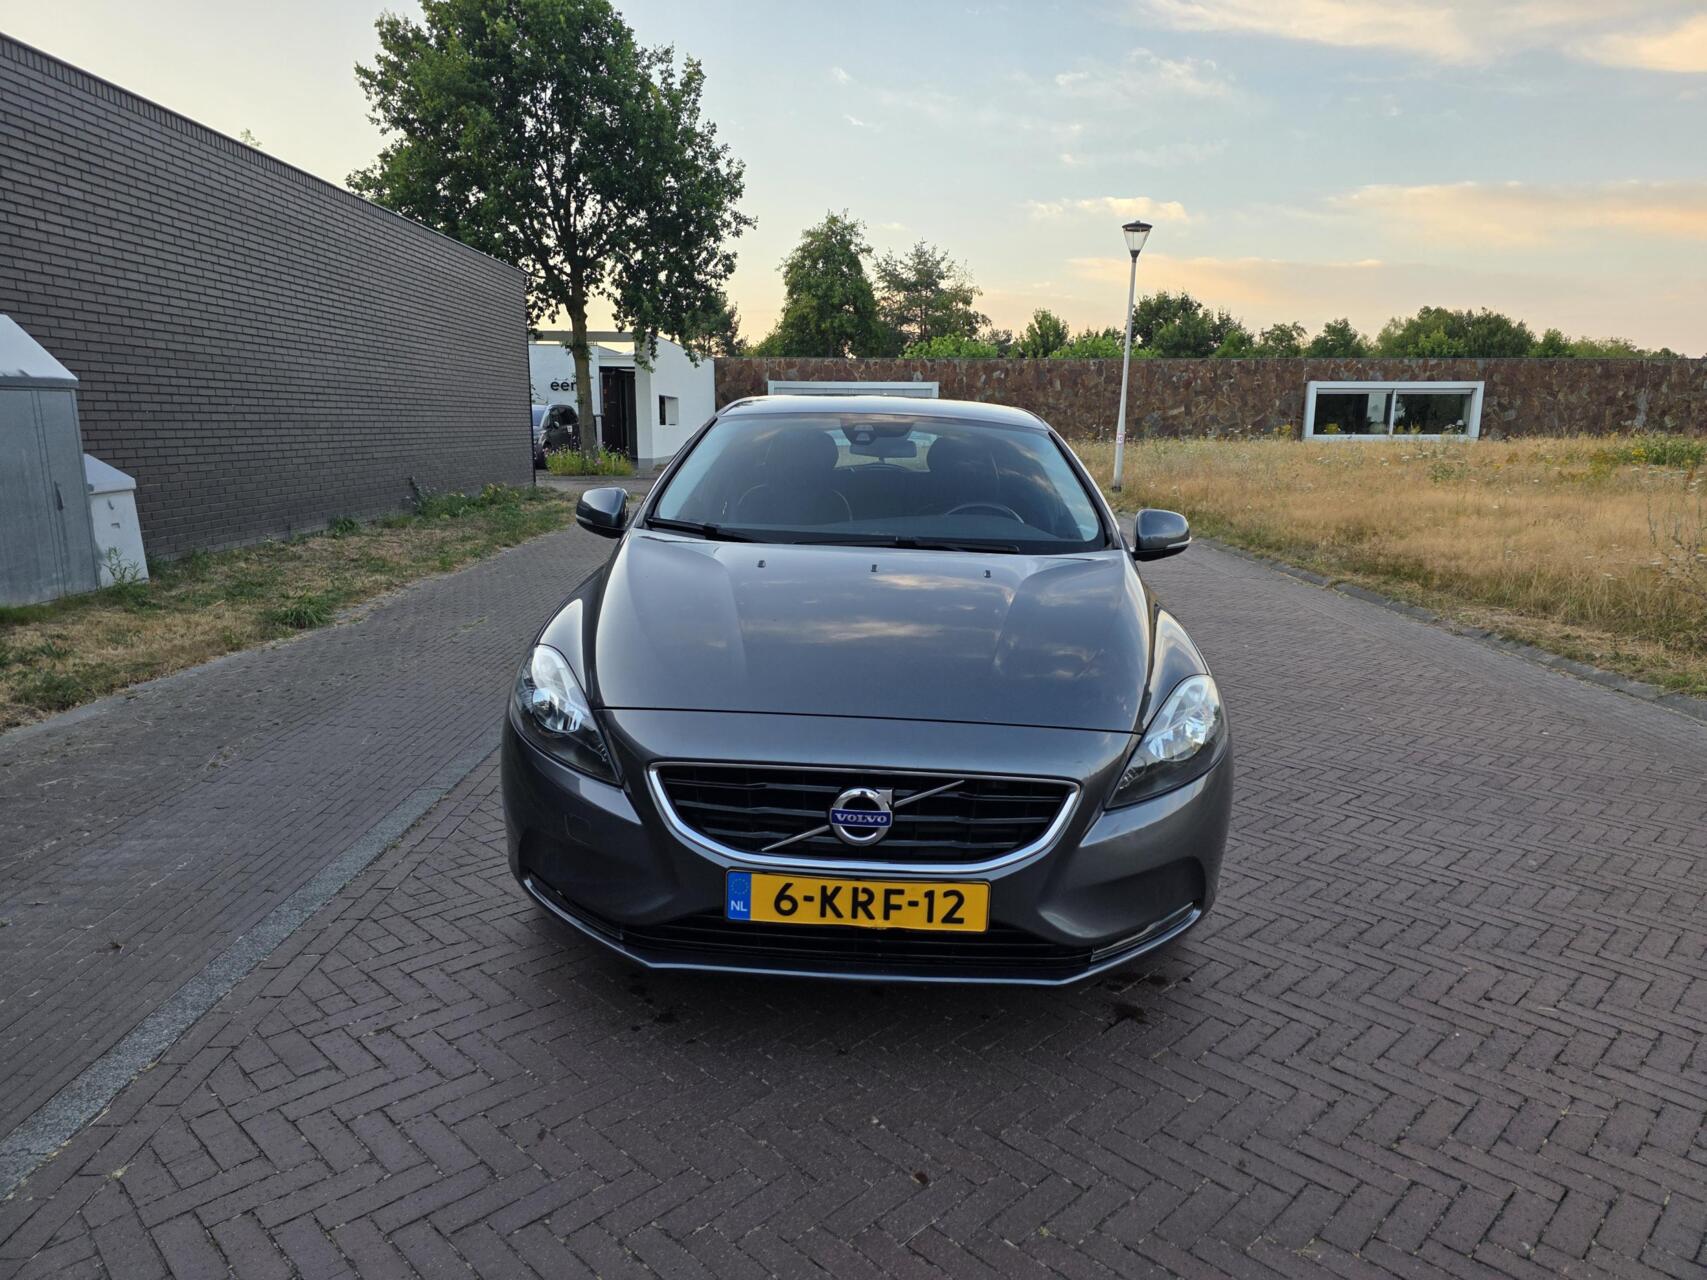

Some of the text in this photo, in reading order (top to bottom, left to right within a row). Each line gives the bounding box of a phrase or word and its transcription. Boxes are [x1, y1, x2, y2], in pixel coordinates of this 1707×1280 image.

[835, 813, 887, 823] VOLVO
[730, 900, 748, 912] NL
[773, 882, 965, 925] 6-KRF-12
